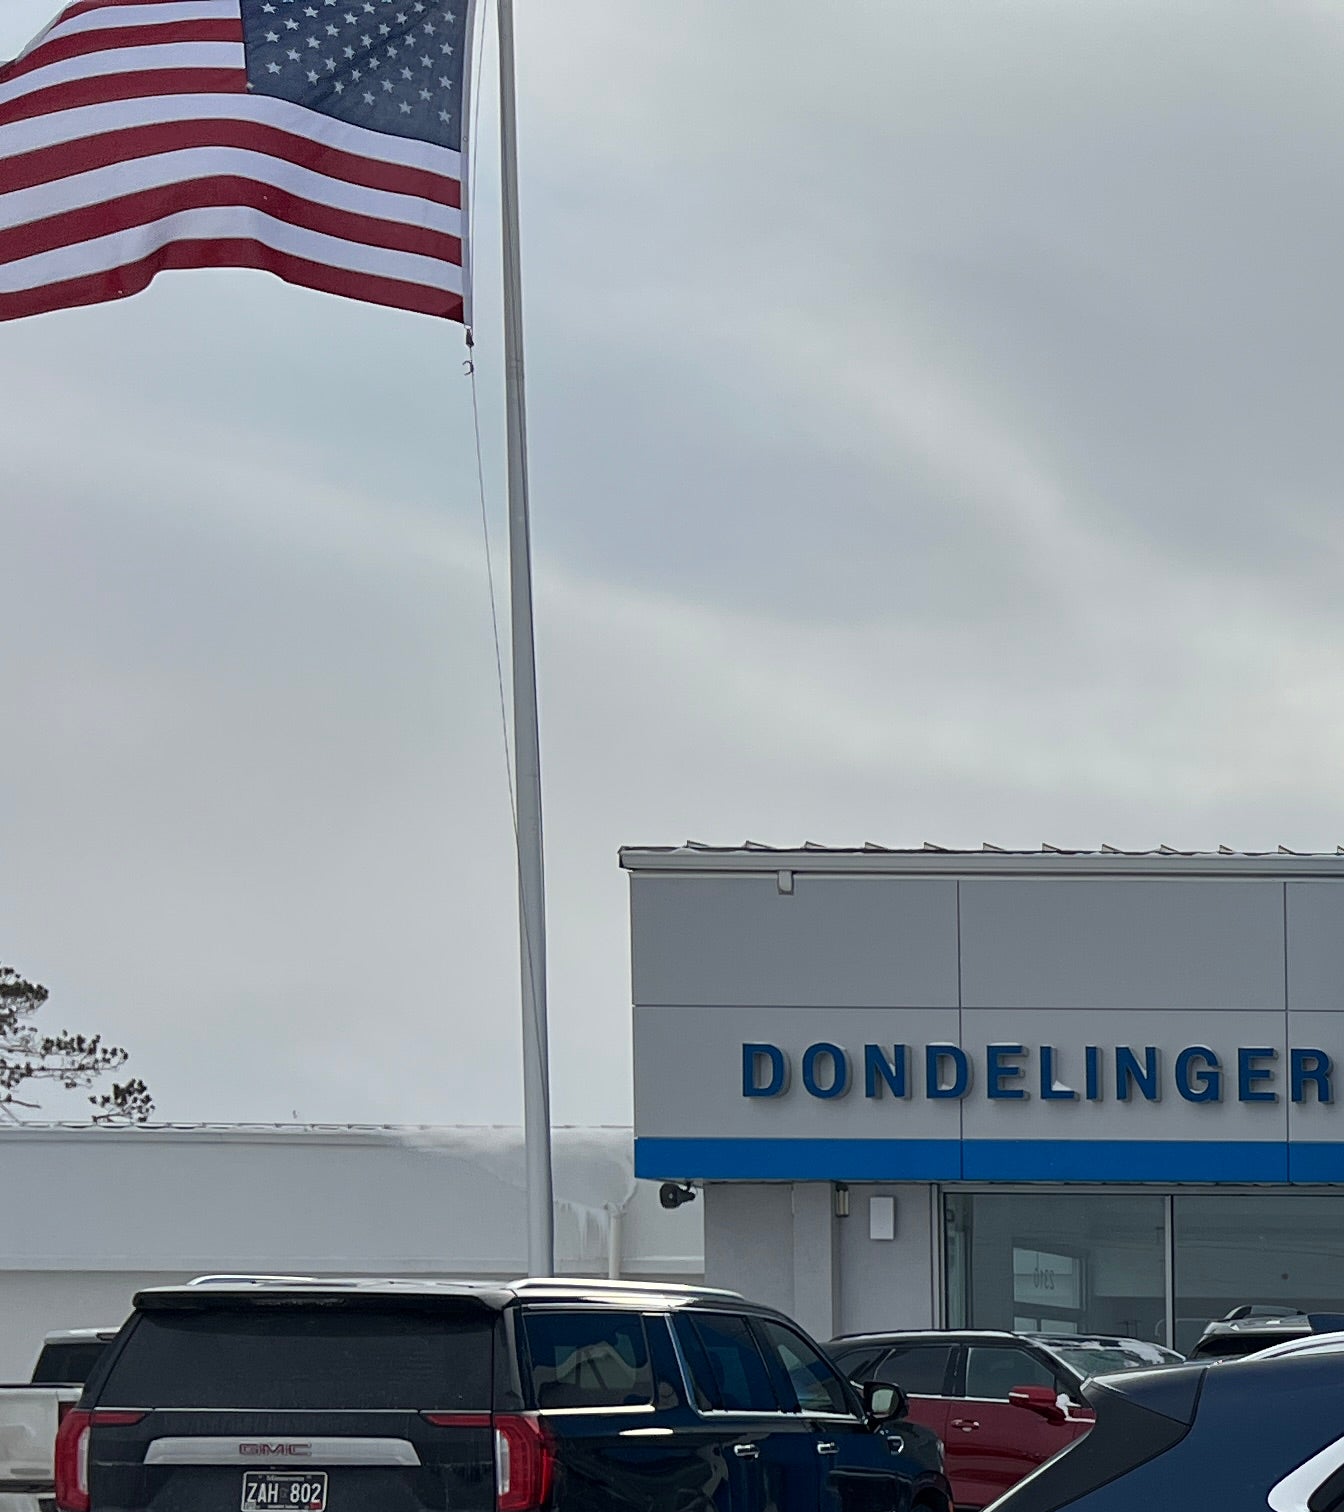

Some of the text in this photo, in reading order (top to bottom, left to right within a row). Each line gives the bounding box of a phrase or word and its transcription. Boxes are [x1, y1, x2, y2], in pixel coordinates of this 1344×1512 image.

[742, 1042, 1333, 1103] DONDELINGER
[239, 1443, 312, 1457] GMC
[247, 1482, 322, 1503] ZAH 802
